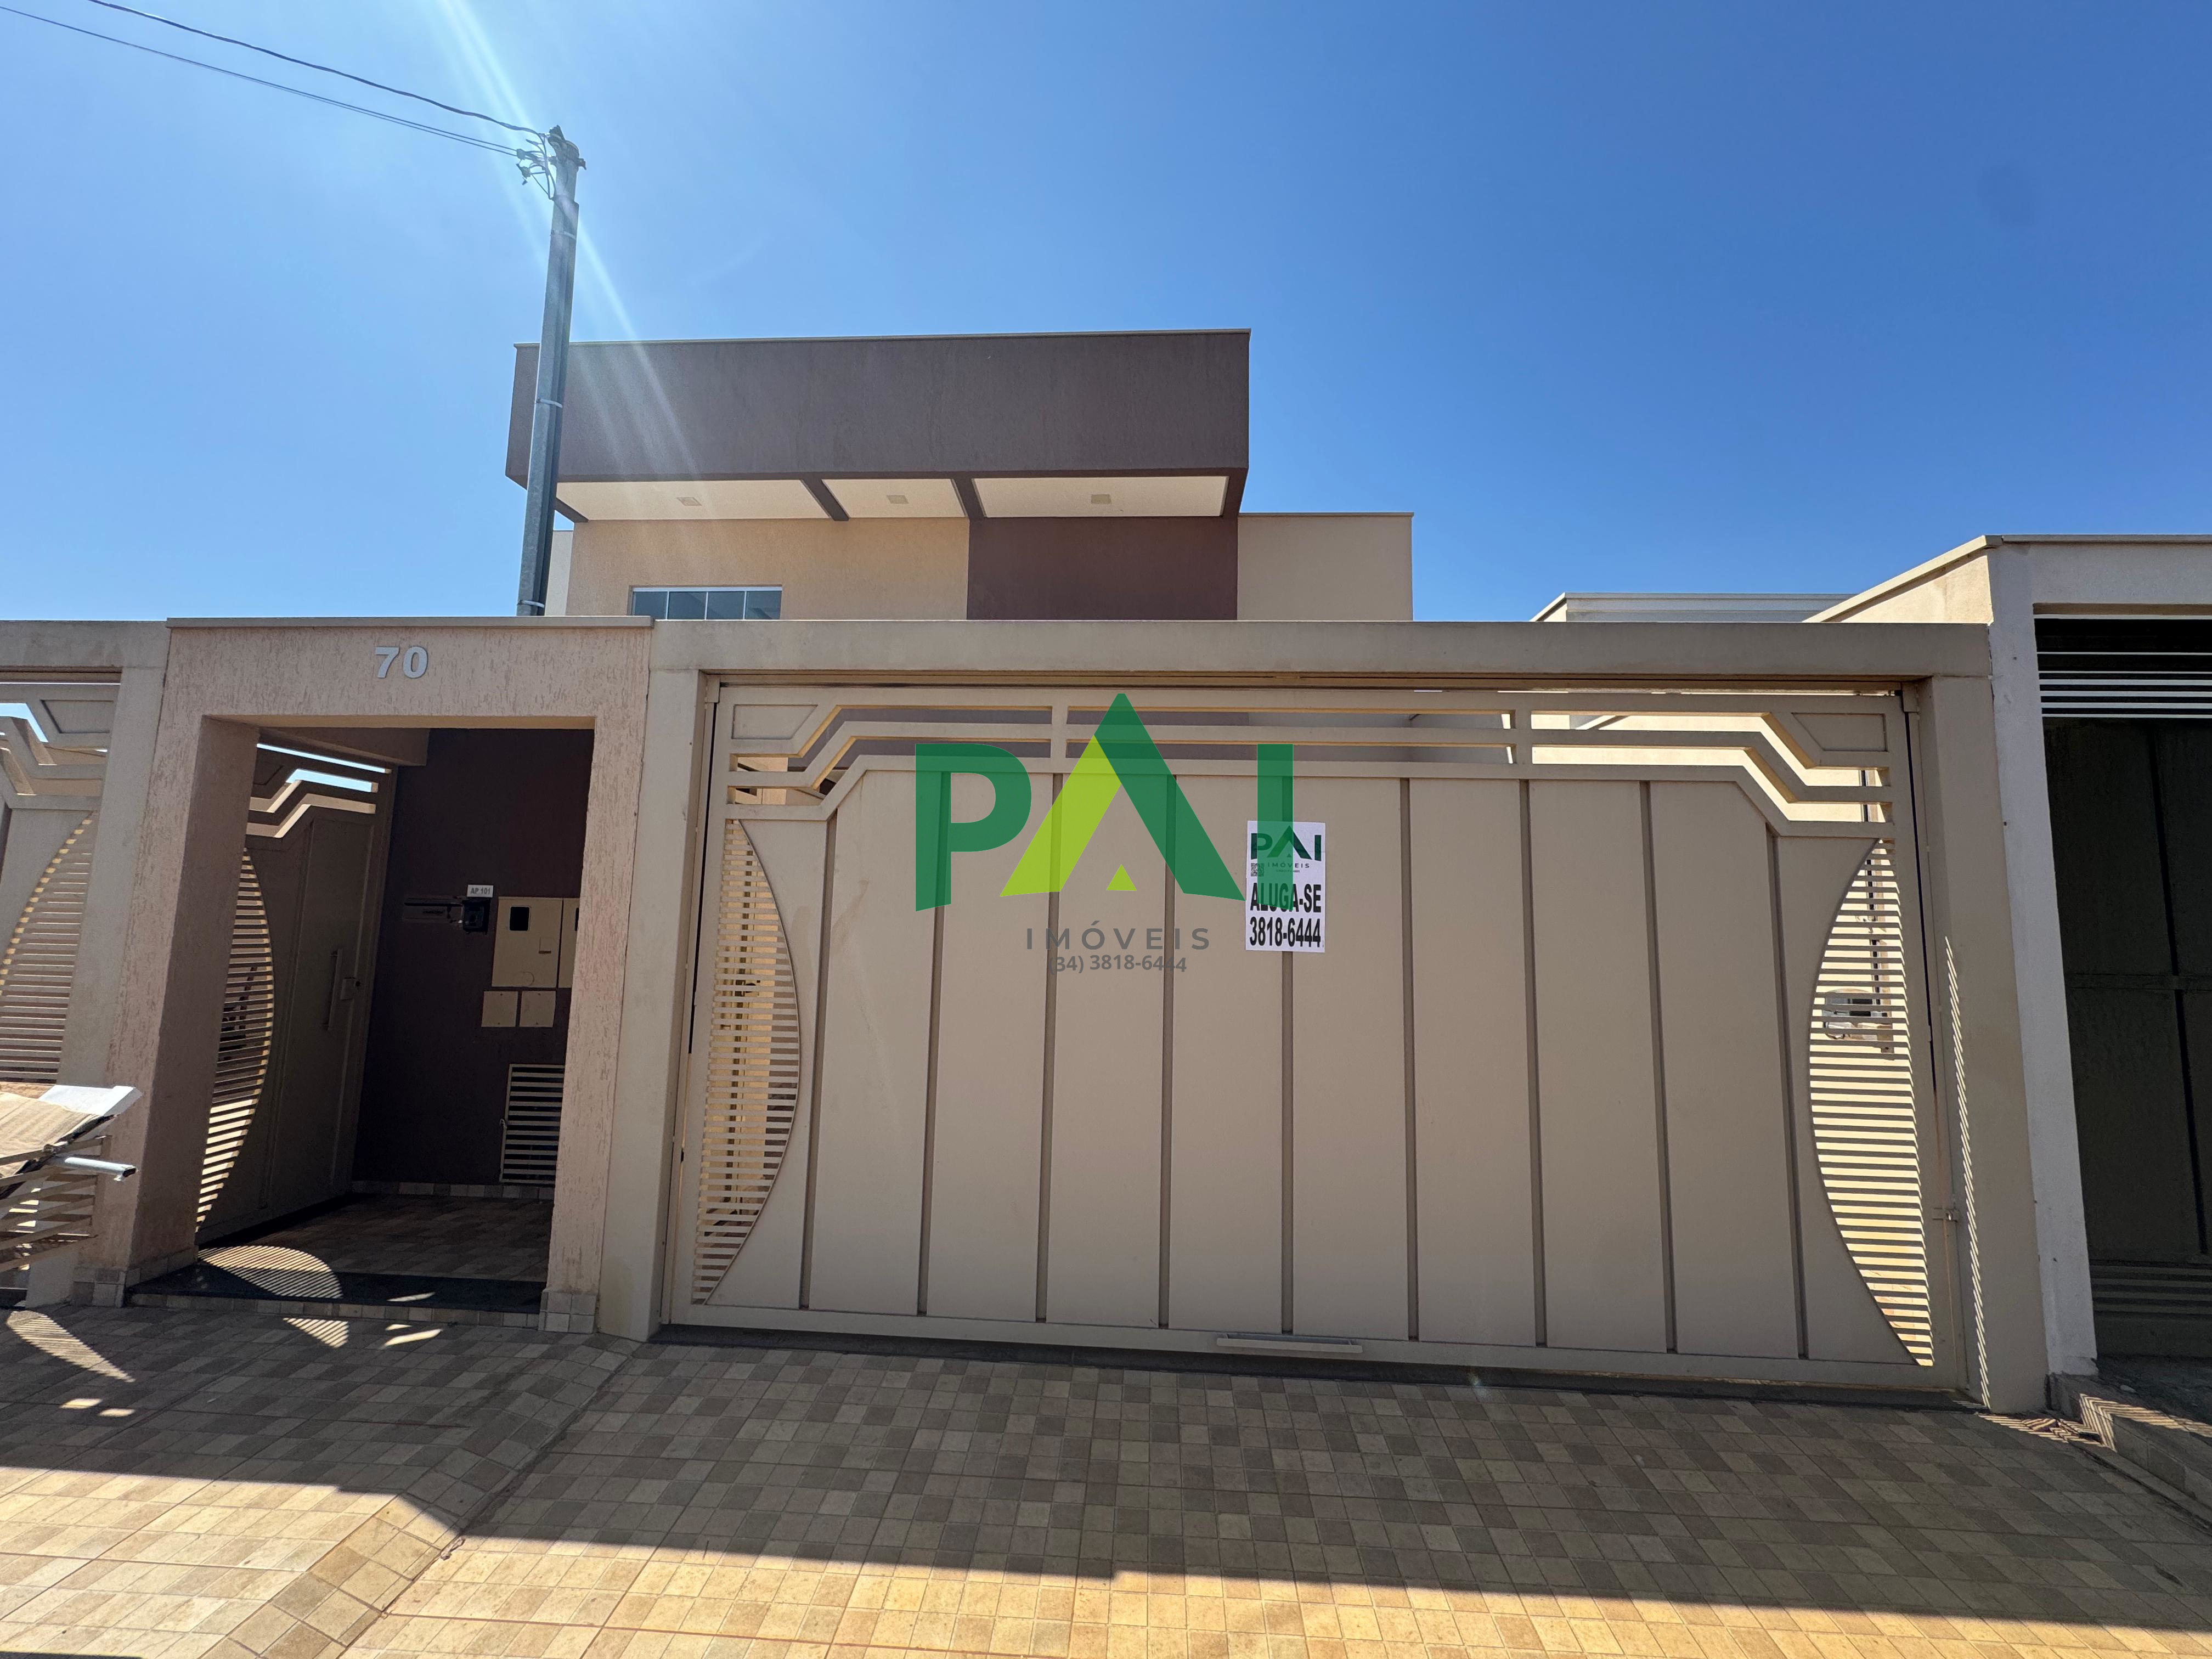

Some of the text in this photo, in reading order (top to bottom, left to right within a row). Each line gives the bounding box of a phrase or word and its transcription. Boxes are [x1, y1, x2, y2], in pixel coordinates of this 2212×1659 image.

[375, 646, 428, 679] 70
[1251, 825, 1322, 861] PAI
[1250, 883, 1322, 913] ALUGA-SE
[1250, 916, 1321, 947] 3818-6444
